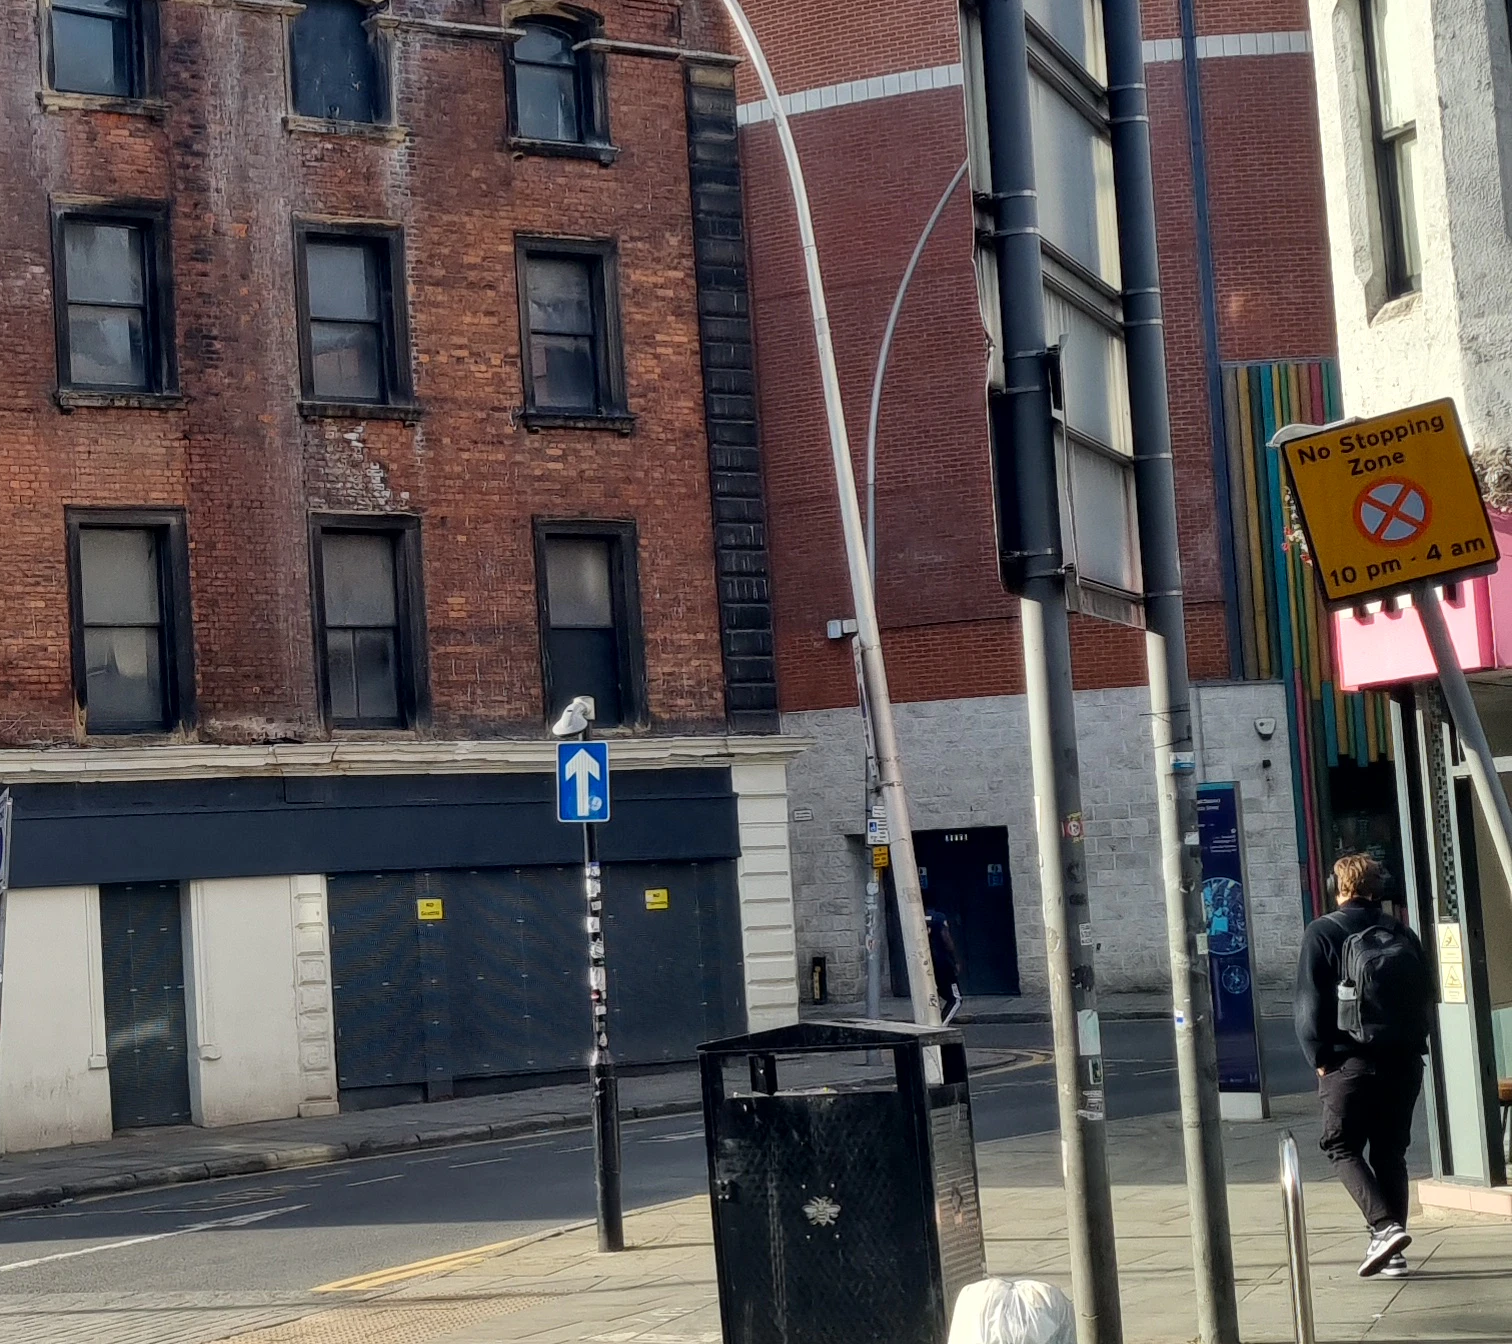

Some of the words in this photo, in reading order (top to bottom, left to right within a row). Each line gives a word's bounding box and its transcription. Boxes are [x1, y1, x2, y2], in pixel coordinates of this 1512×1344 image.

[1297, 444, 1331, 466] No
[1340, 414, 1445, 455] Stopping
[1348, 450, 1406, 476] Zone
[1329, 564, 1358, 587] 10
[1367, 555, 1402, 580] pm
[1426, 543, 1442, 561] 4
[1450, 536, 1486, 557] am
